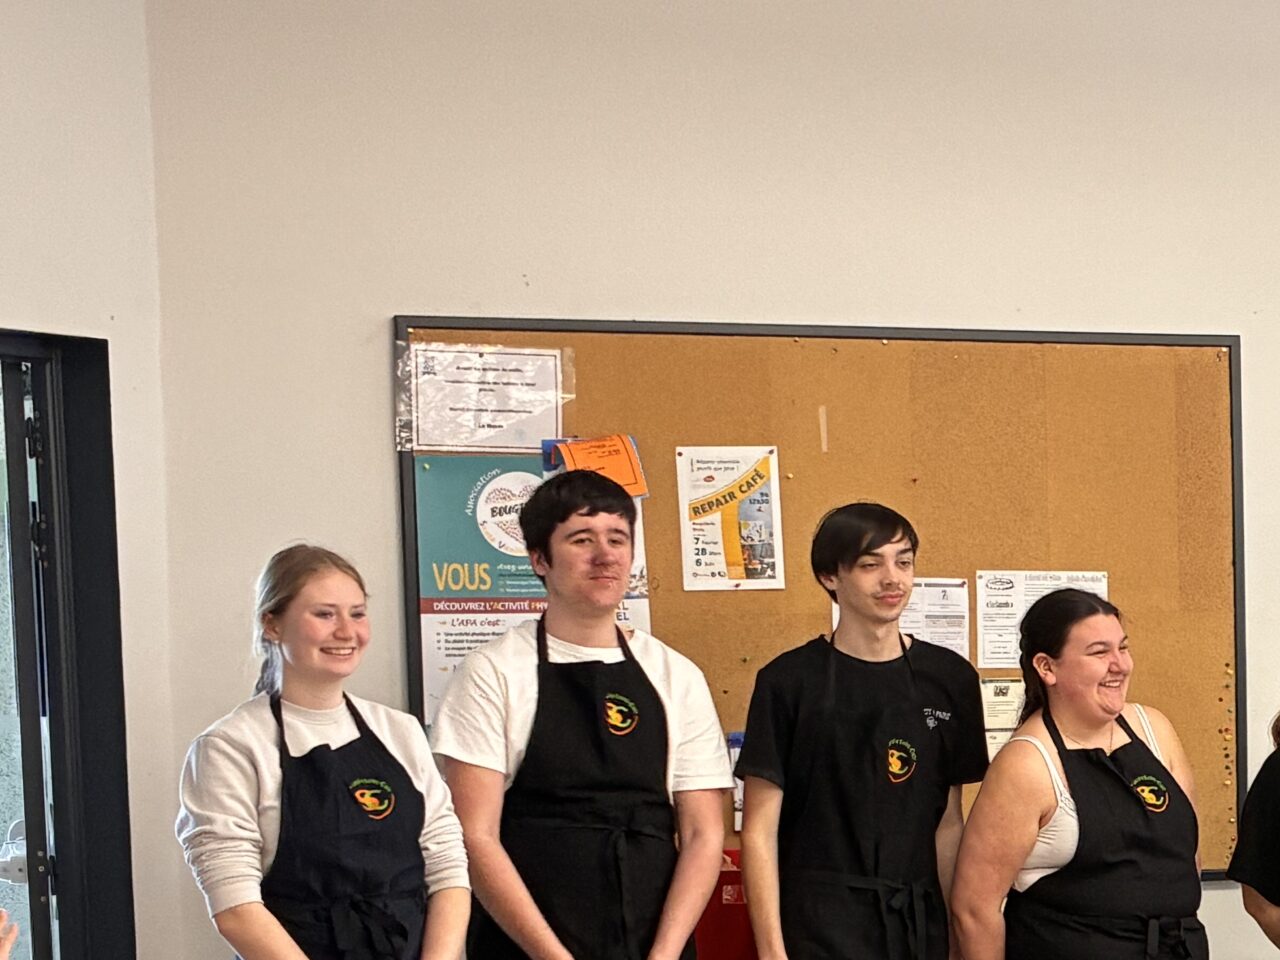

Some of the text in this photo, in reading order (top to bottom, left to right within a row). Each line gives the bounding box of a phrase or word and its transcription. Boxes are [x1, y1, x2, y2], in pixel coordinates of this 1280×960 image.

[692, 468, 765, 516] REPAIR CAFÉ
[694, 537, 700, 545] 7
[694, 548, 707, 556] 28
[695, 558, 702, 567] 6
[432, 562, 492, 591] VOUS
[433, 601, 484, 611] DÉCOUVREZ
[486, 601, 529, 610] L'ACTIVITÉ
